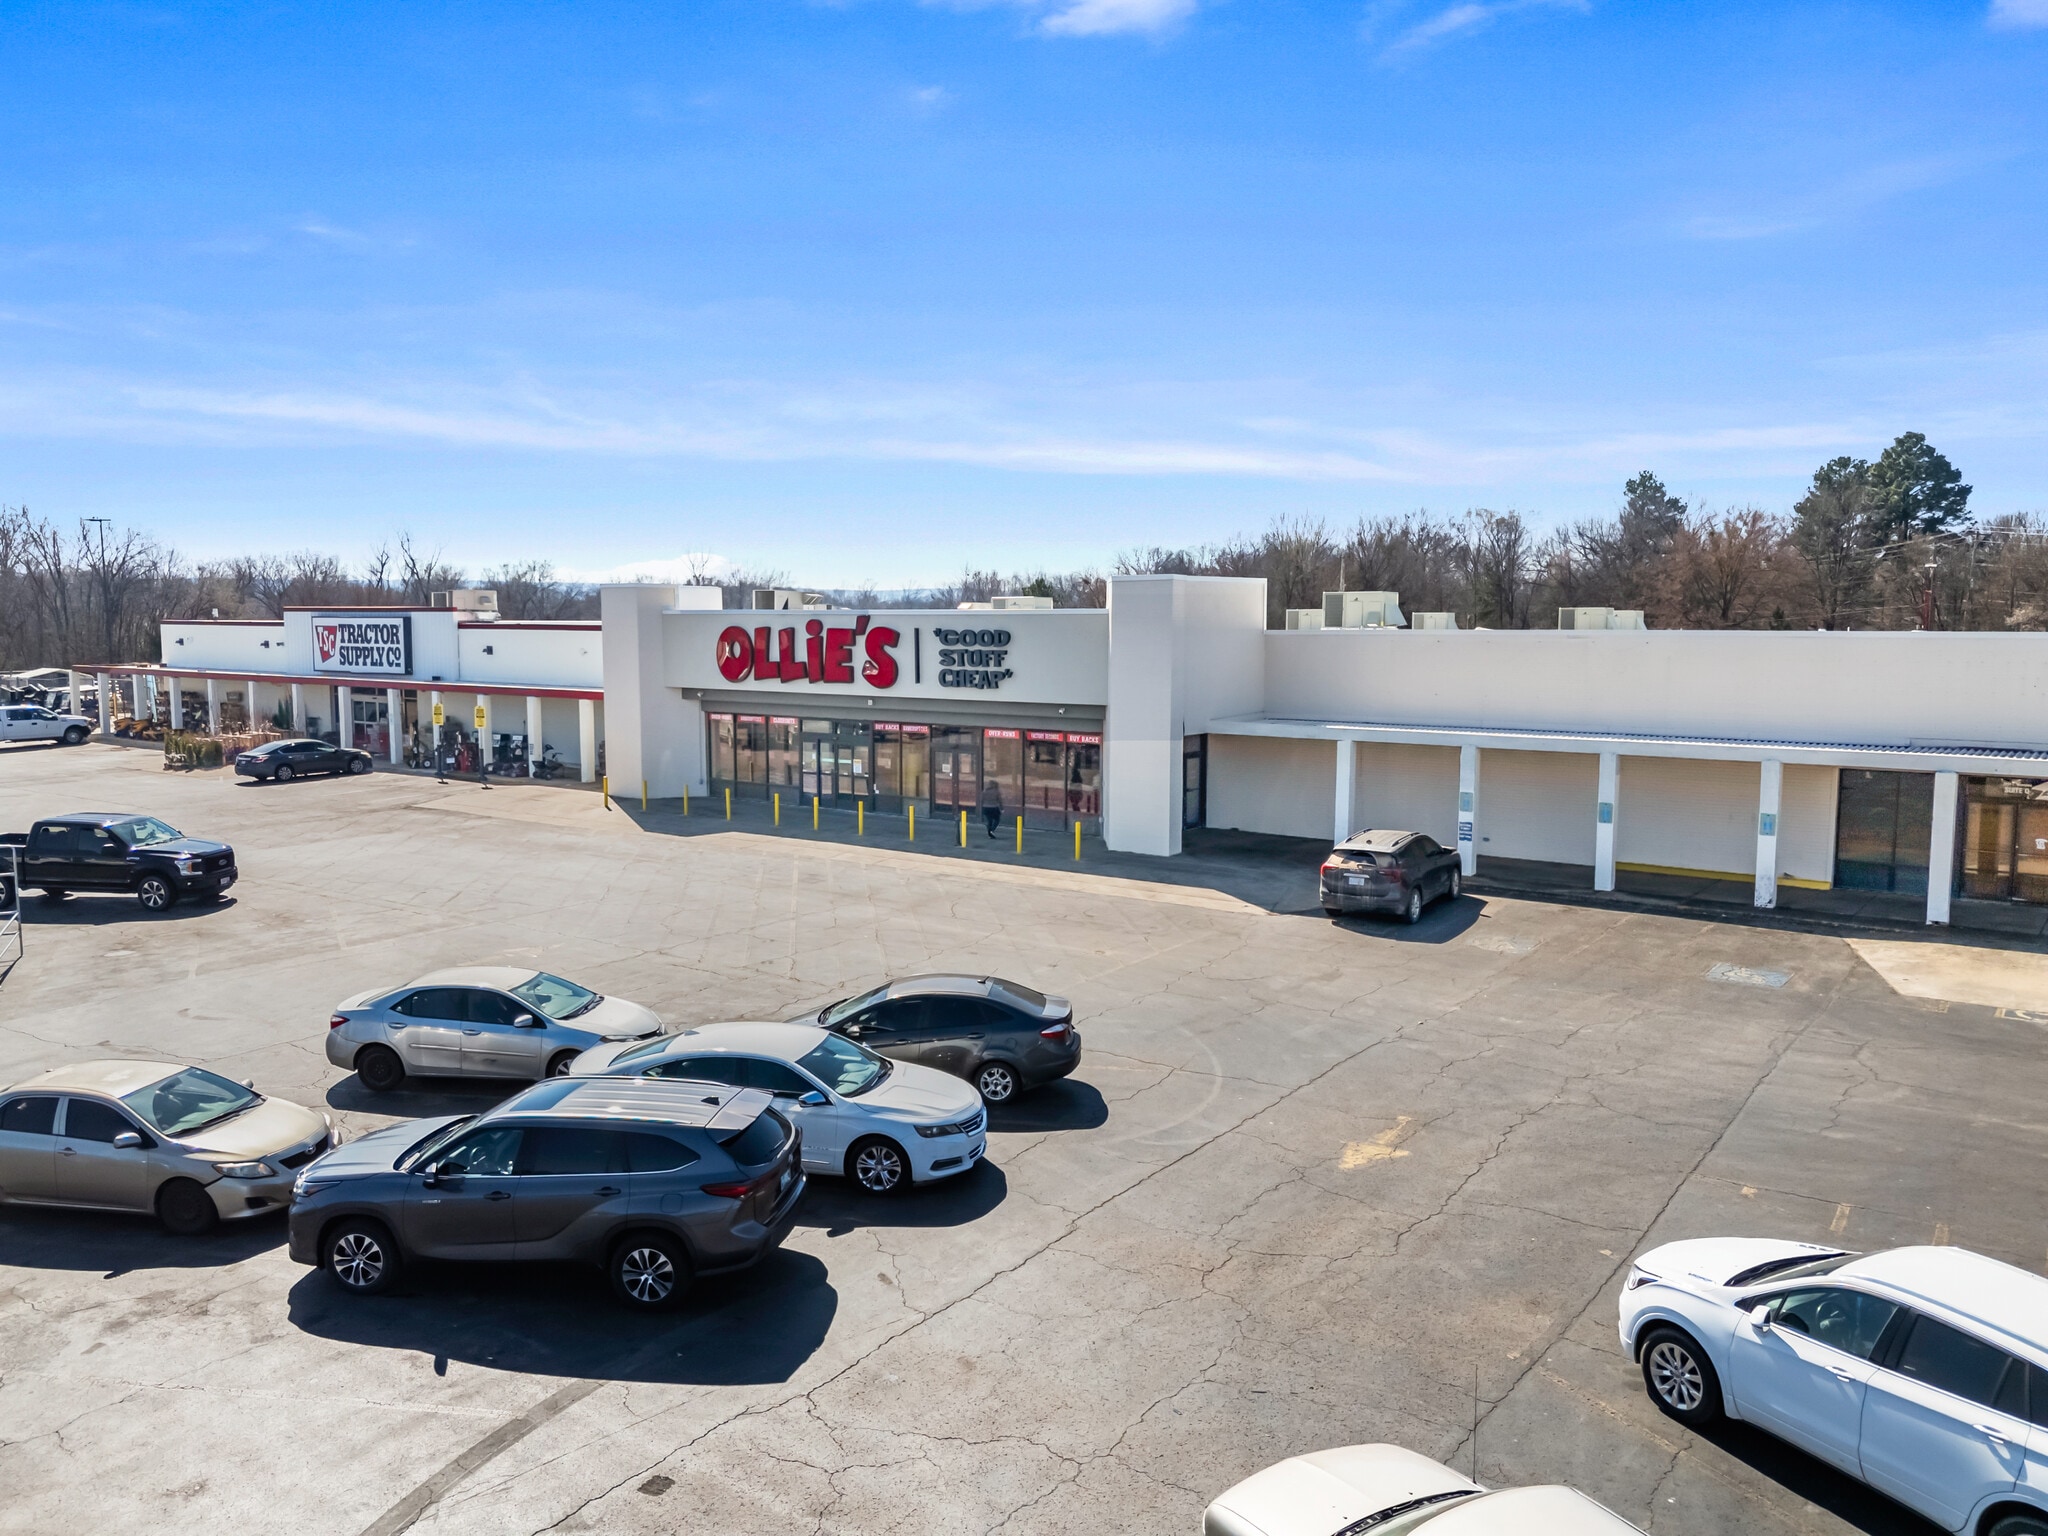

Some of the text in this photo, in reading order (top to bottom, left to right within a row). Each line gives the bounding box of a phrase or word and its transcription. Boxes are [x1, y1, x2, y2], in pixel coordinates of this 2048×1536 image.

[317, 626, 335, 656] TSC
[338, 623, 400, 645] TRACTOR
[339, 645, 385, 667] SUPPLY
[939, 649, 1008, 667] STUFF
[1070, 734, 1099, 743] BUY BACKS
